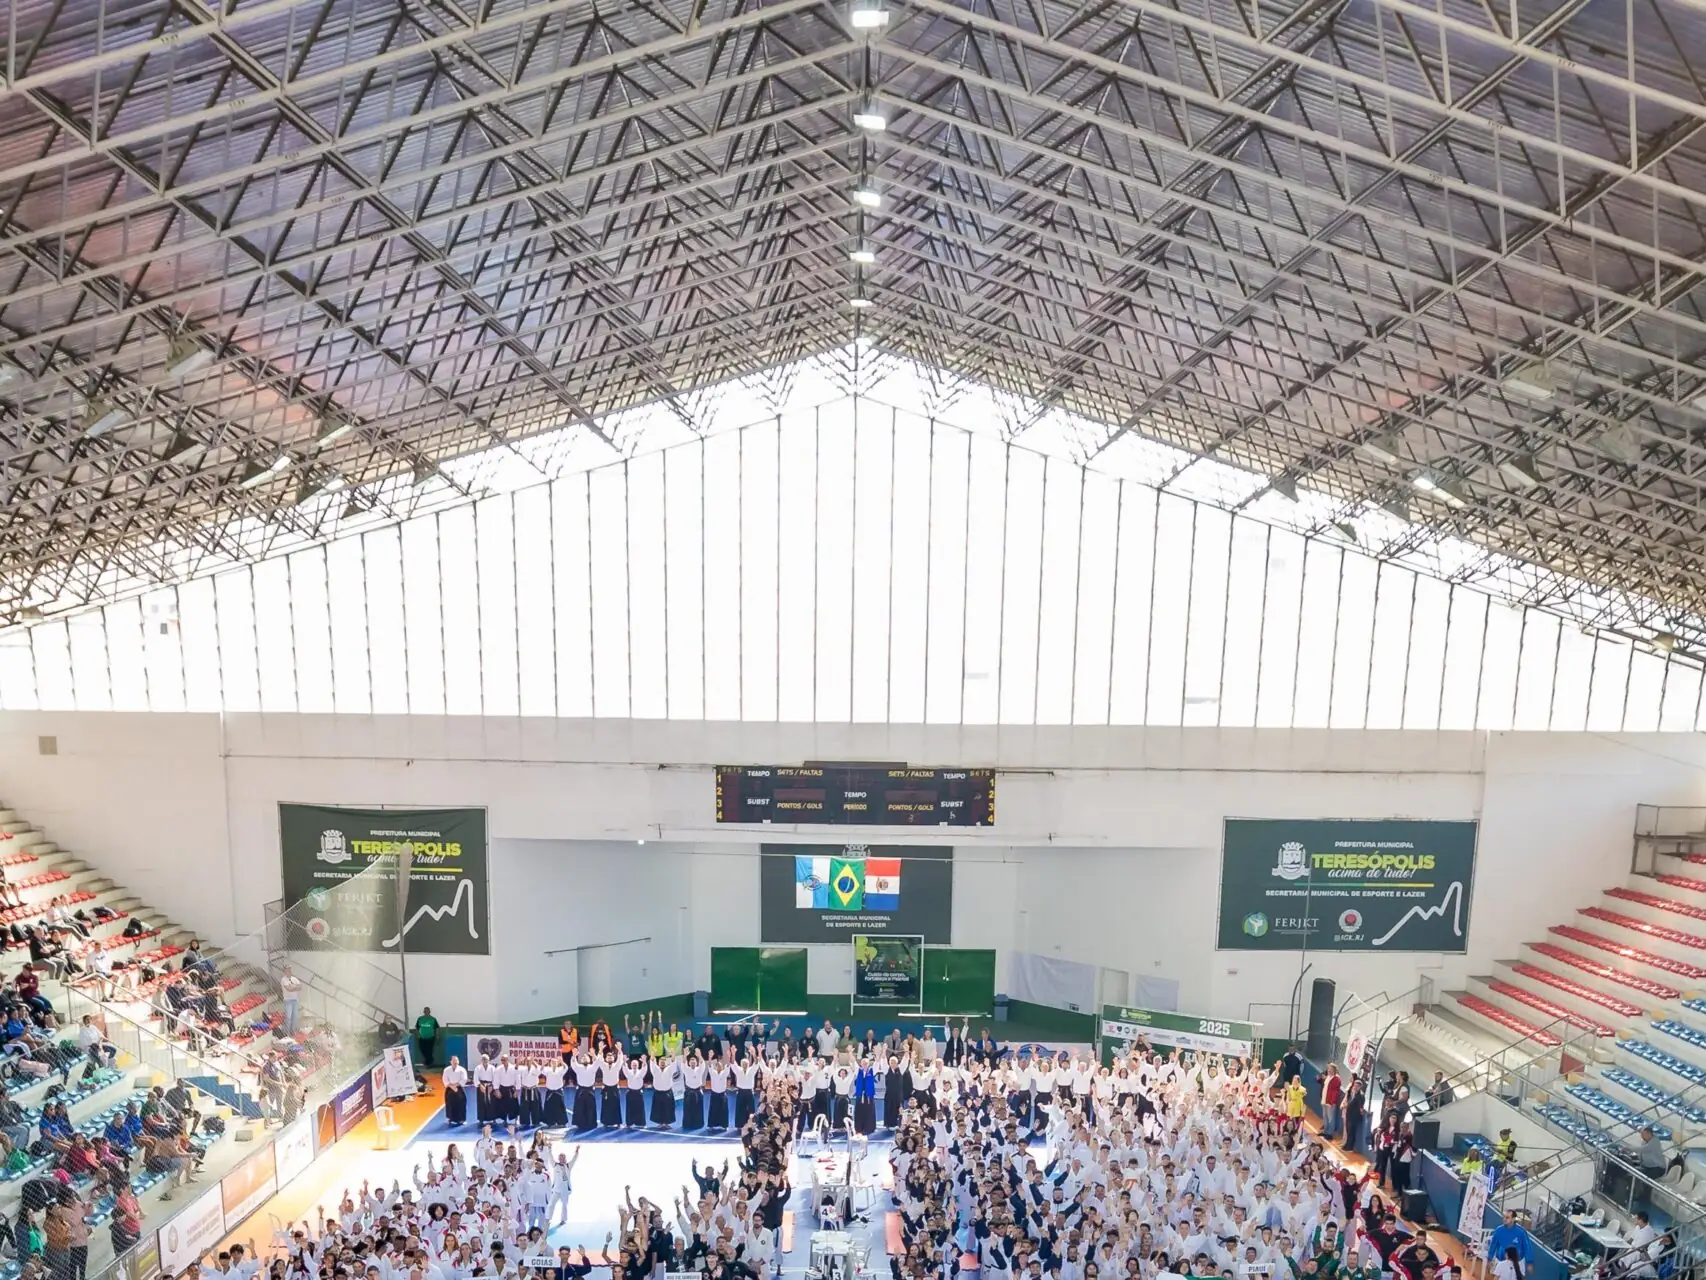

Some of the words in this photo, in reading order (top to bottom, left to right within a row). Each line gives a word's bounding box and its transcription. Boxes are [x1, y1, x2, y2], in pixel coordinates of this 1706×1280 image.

[717, 774, 722, 783] 1
[990, 778, 995, 787] 1
[716, 787, 722, 796] 2
[988, 790, 994, 798] 2
[717, 799, 722, 808] 3
[988, 802, 994, 811] 3
[716, 811, 723, 819] 4
[987, 815, 993, 824] 4
[1311, 851, 1435, 870] TERESÓPOLIS
[313, 871, 353, 879] SECRETARIA
[1328, 865, 1361, 878] acima
[1366, 867, 1380, 878] de
[1384, 864, 1415, 879] tudo!
[1275, 918, 1319, 929] FERJKT
[1199, 1020, 1231, 1036] 2025
[509, 1040, 523, 1049] NÃO
[525, 1041, 534, 1049] HÁ
[535, 1041, 557, 1050] MAGIA
[822, 1208, 828, 1216] 4
[835, 1272, 842, 1280] 3
